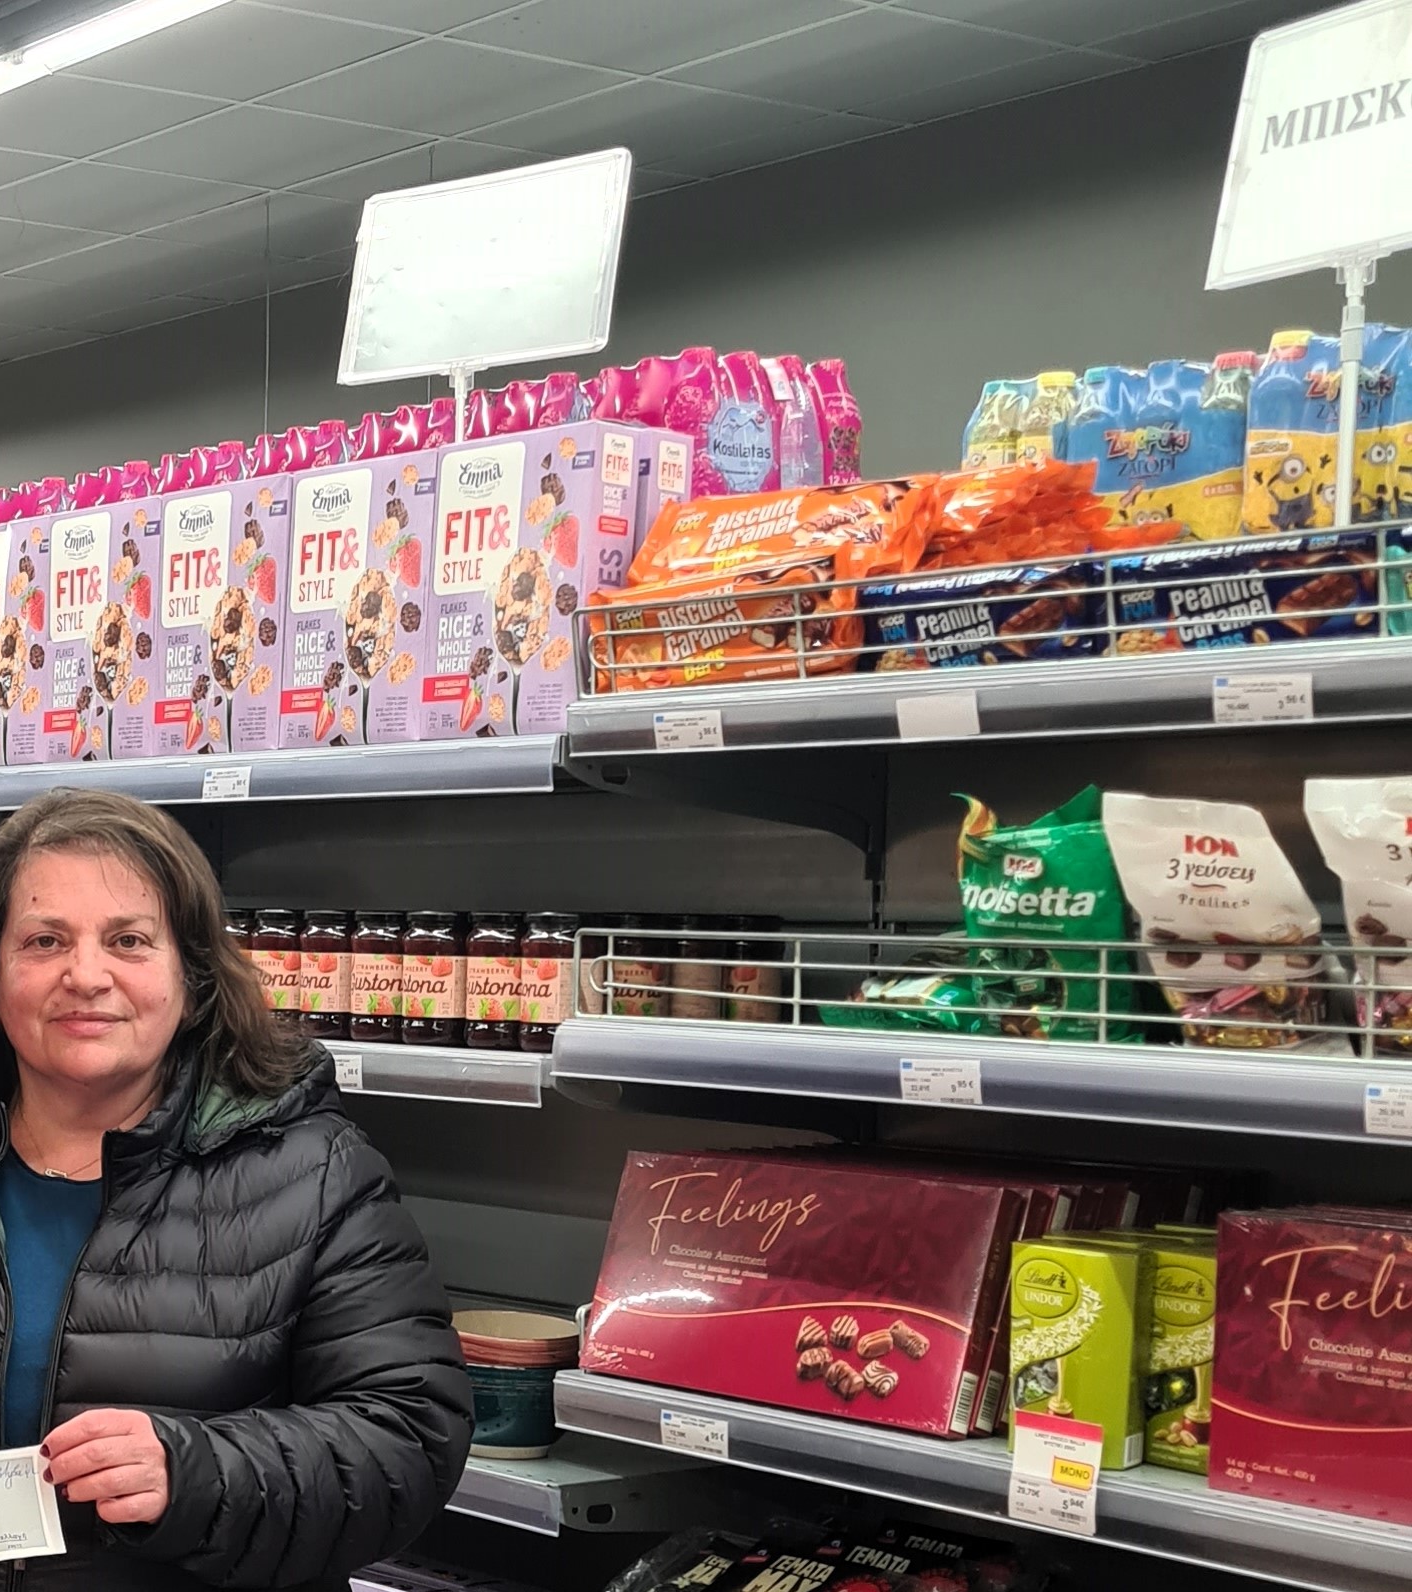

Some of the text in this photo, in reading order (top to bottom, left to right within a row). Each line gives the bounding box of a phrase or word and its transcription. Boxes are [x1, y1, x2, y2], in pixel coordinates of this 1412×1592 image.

[1260, 78, 1412, 155] ΜΠΙΣΚ
[713, 438, 772, 460] Kostilatas
[459, 462, 503, 488] Emma
[312, 487, 353, 512] Emma
[179, 510, 214, 532] Emma
[444, 504, 511, 556] FIT&
[64, 529, 96, 551] Emma
[300, 527, 360, 575] FIT&
[169, 547, 222, 592] FIT&
[442, 558, 483, 584] STYLE
[57, 565, 102, 609] FIT&
[299, 577, 335, 602] STYLE
[1120, 589, 1156, 605] CHOCO
[168, 595, 200, 618] STYLE
[440, 601, 468, 615] FLAKES
[1123, 601, 1156, 622] FUN
[56, 610, 84, 633] STYLE
[296, 620, 321, 631] FLAKES
[878, 613, 906, 629] CHOCO
[168, 634, 189, 646] FLAKES
[882, 624, 908, 642] FUN
[55, 648, 75, 659] FLAKES
[438, 640, 471, 657] WHOLE
[294, 654, 325, 670] WHOLE
[436, 656, 470, 674] WHEAT
[166, 667, 193, 683] WHOLE
[293, 670, 323, 687] WHEAT
[54, 680, 77, 694] WHOLE
[166, 682, 191, 698] WHEAT
[1184, 834, 1239, 858] ION
[1386, 843, 1402, 861] 3
[1167, 858, 1257, 884] 3 γεύσεις
[962, 882, 1097, 917] noisetta
[1178, 893, 1250, 910] Pralines
[648, 1172, 823, 1256] Feelings
[669, 1244, 767, 1267] Chocolate Assortment
[1024, 1270, 1057, 1287] Lindt
[1157, 1275, 1196, 1294] Lindt
[1025, 1291, 1064, 1308] LINDOR
[1261, 1245, 1412, 1351] Feeli
[1309, 1338, 1374, 1358] Chocolate
[1226, 1467, 1244, 1479] 400
[1062, 1500, 1069, 1510] 5
[905, 1535, 964, 1558] ΓΕΜΑΤΑ
[769, 1554, 836, 1582] ΓΕΜΑΤΑ
[846, 1546, 911, 1574] ΓΕΜΑΤΑ
